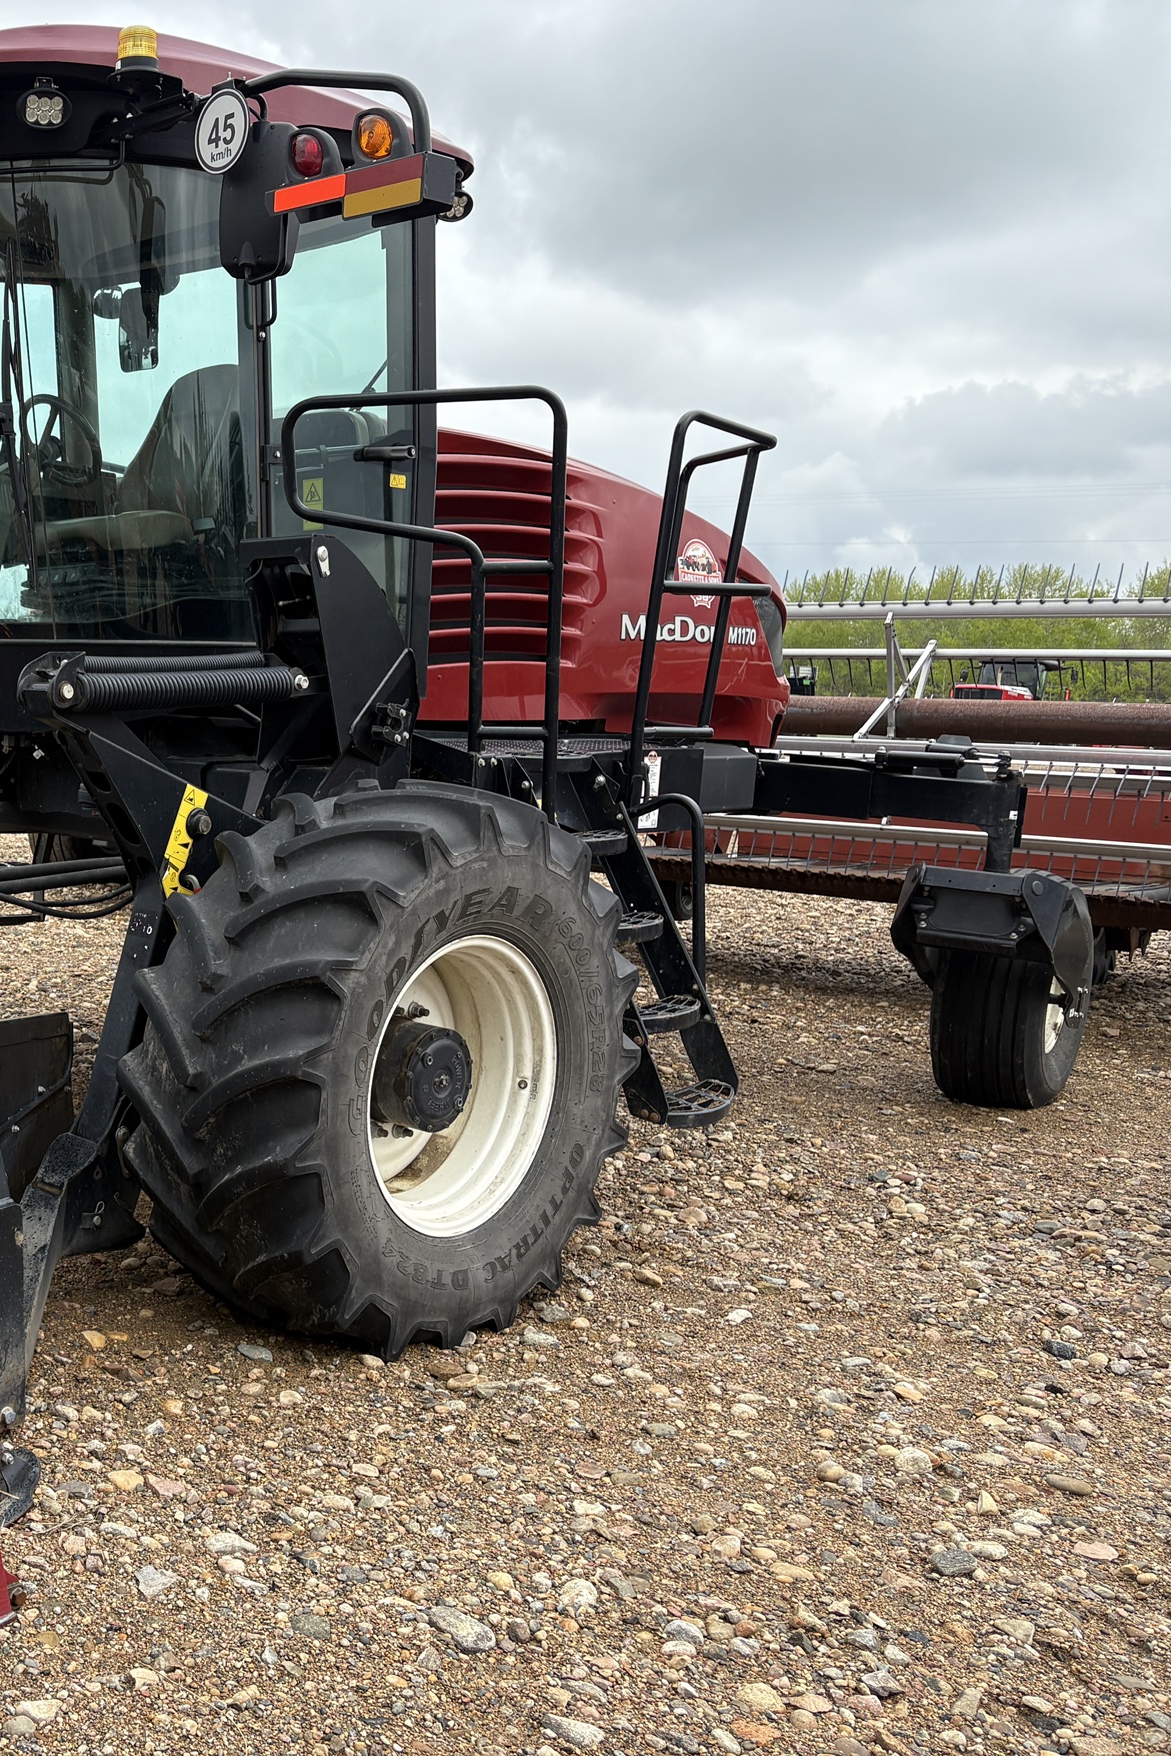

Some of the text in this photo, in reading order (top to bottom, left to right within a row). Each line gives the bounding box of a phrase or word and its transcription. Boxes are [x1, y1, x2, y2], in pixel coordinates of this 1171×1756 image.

[208, 112, 235, 149] 45
[211, 147, 232, 163] km/h
[728, 627, 756, 645] M1170
[348, 885, 553, 1137] GOODYEAR
[557, 916, 606, 1093] 600/65R28
[483, 1142, 584, 1284] OPTITRAC
[382, 1237, 470, 1291] DT824
